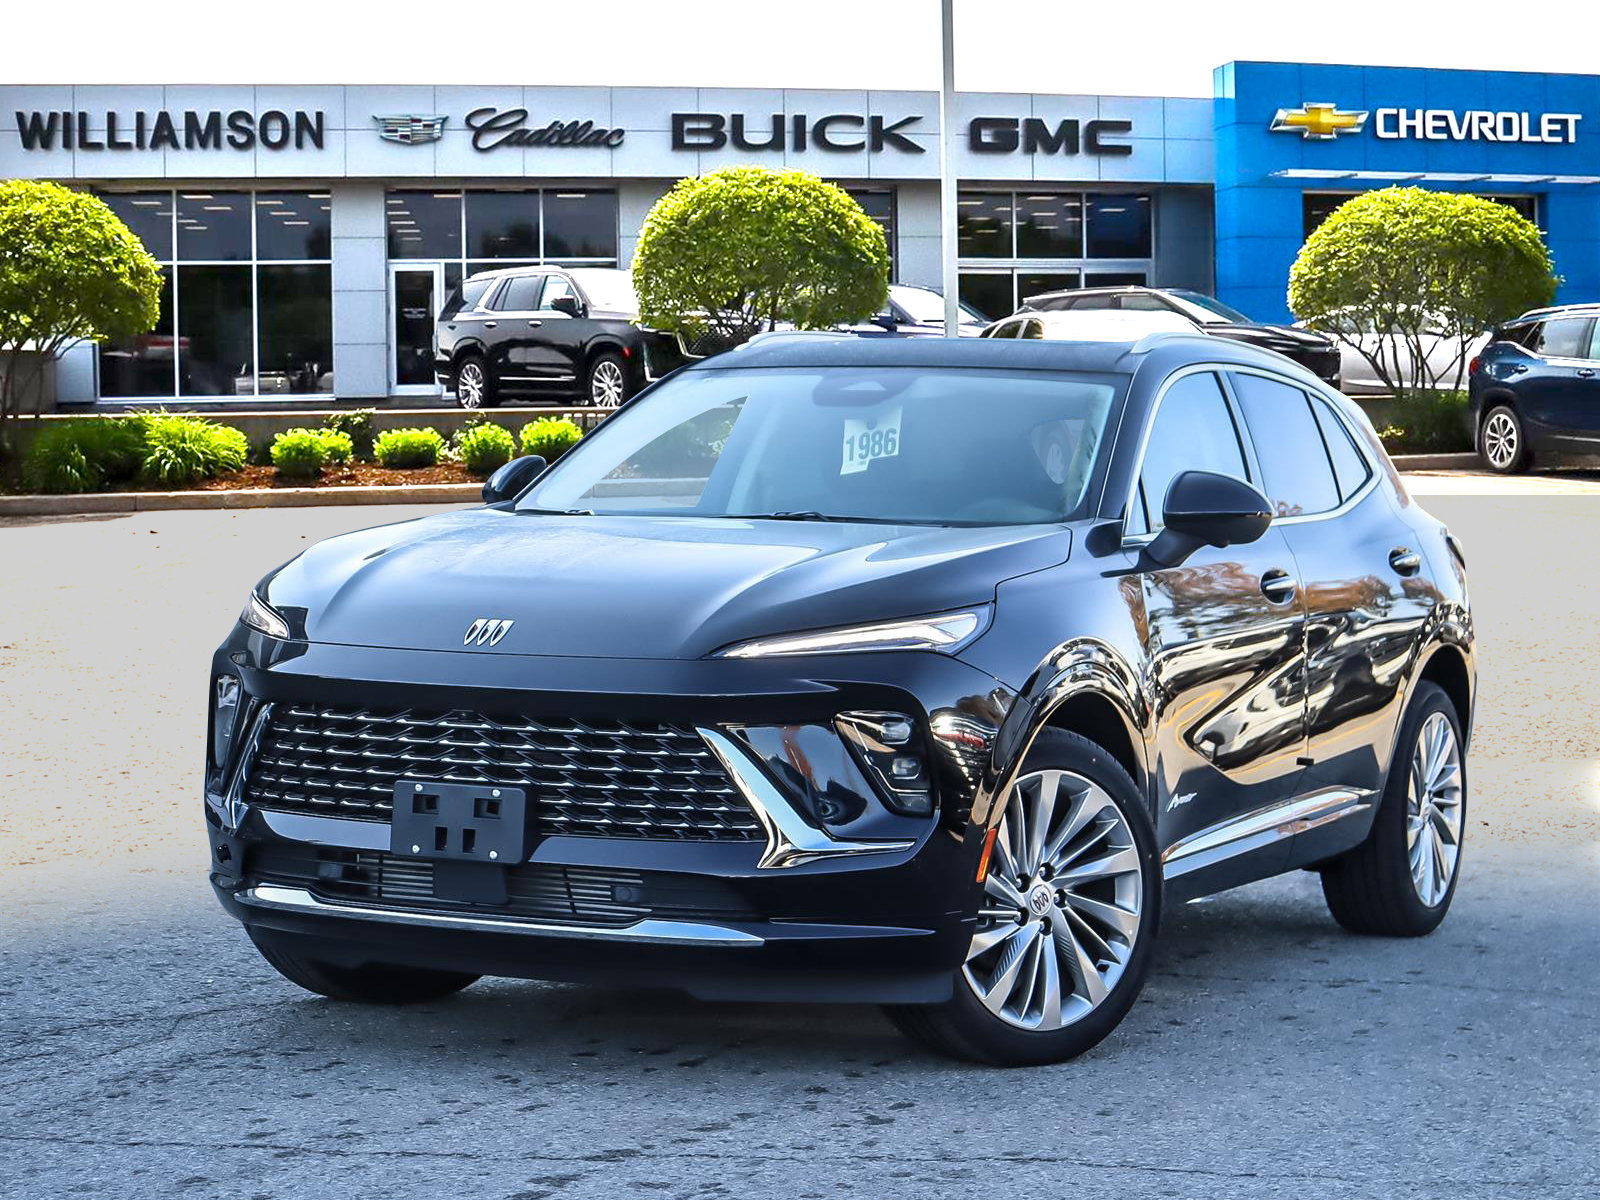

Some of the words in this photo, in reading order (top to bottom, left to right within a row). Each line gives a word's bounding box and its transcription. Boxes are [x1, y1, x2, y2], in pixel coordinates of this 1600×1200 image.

[16, 110, 324, 150] WILLIAMSON
[464, 107, 625, 152] Cadillac
[671, 113, 925, 153] BUICK
[968, 117, 1133, 155] GMC
[1376, 107, 1581, 143] CHEVROLET
[846, 428, 897, 462] 1986
